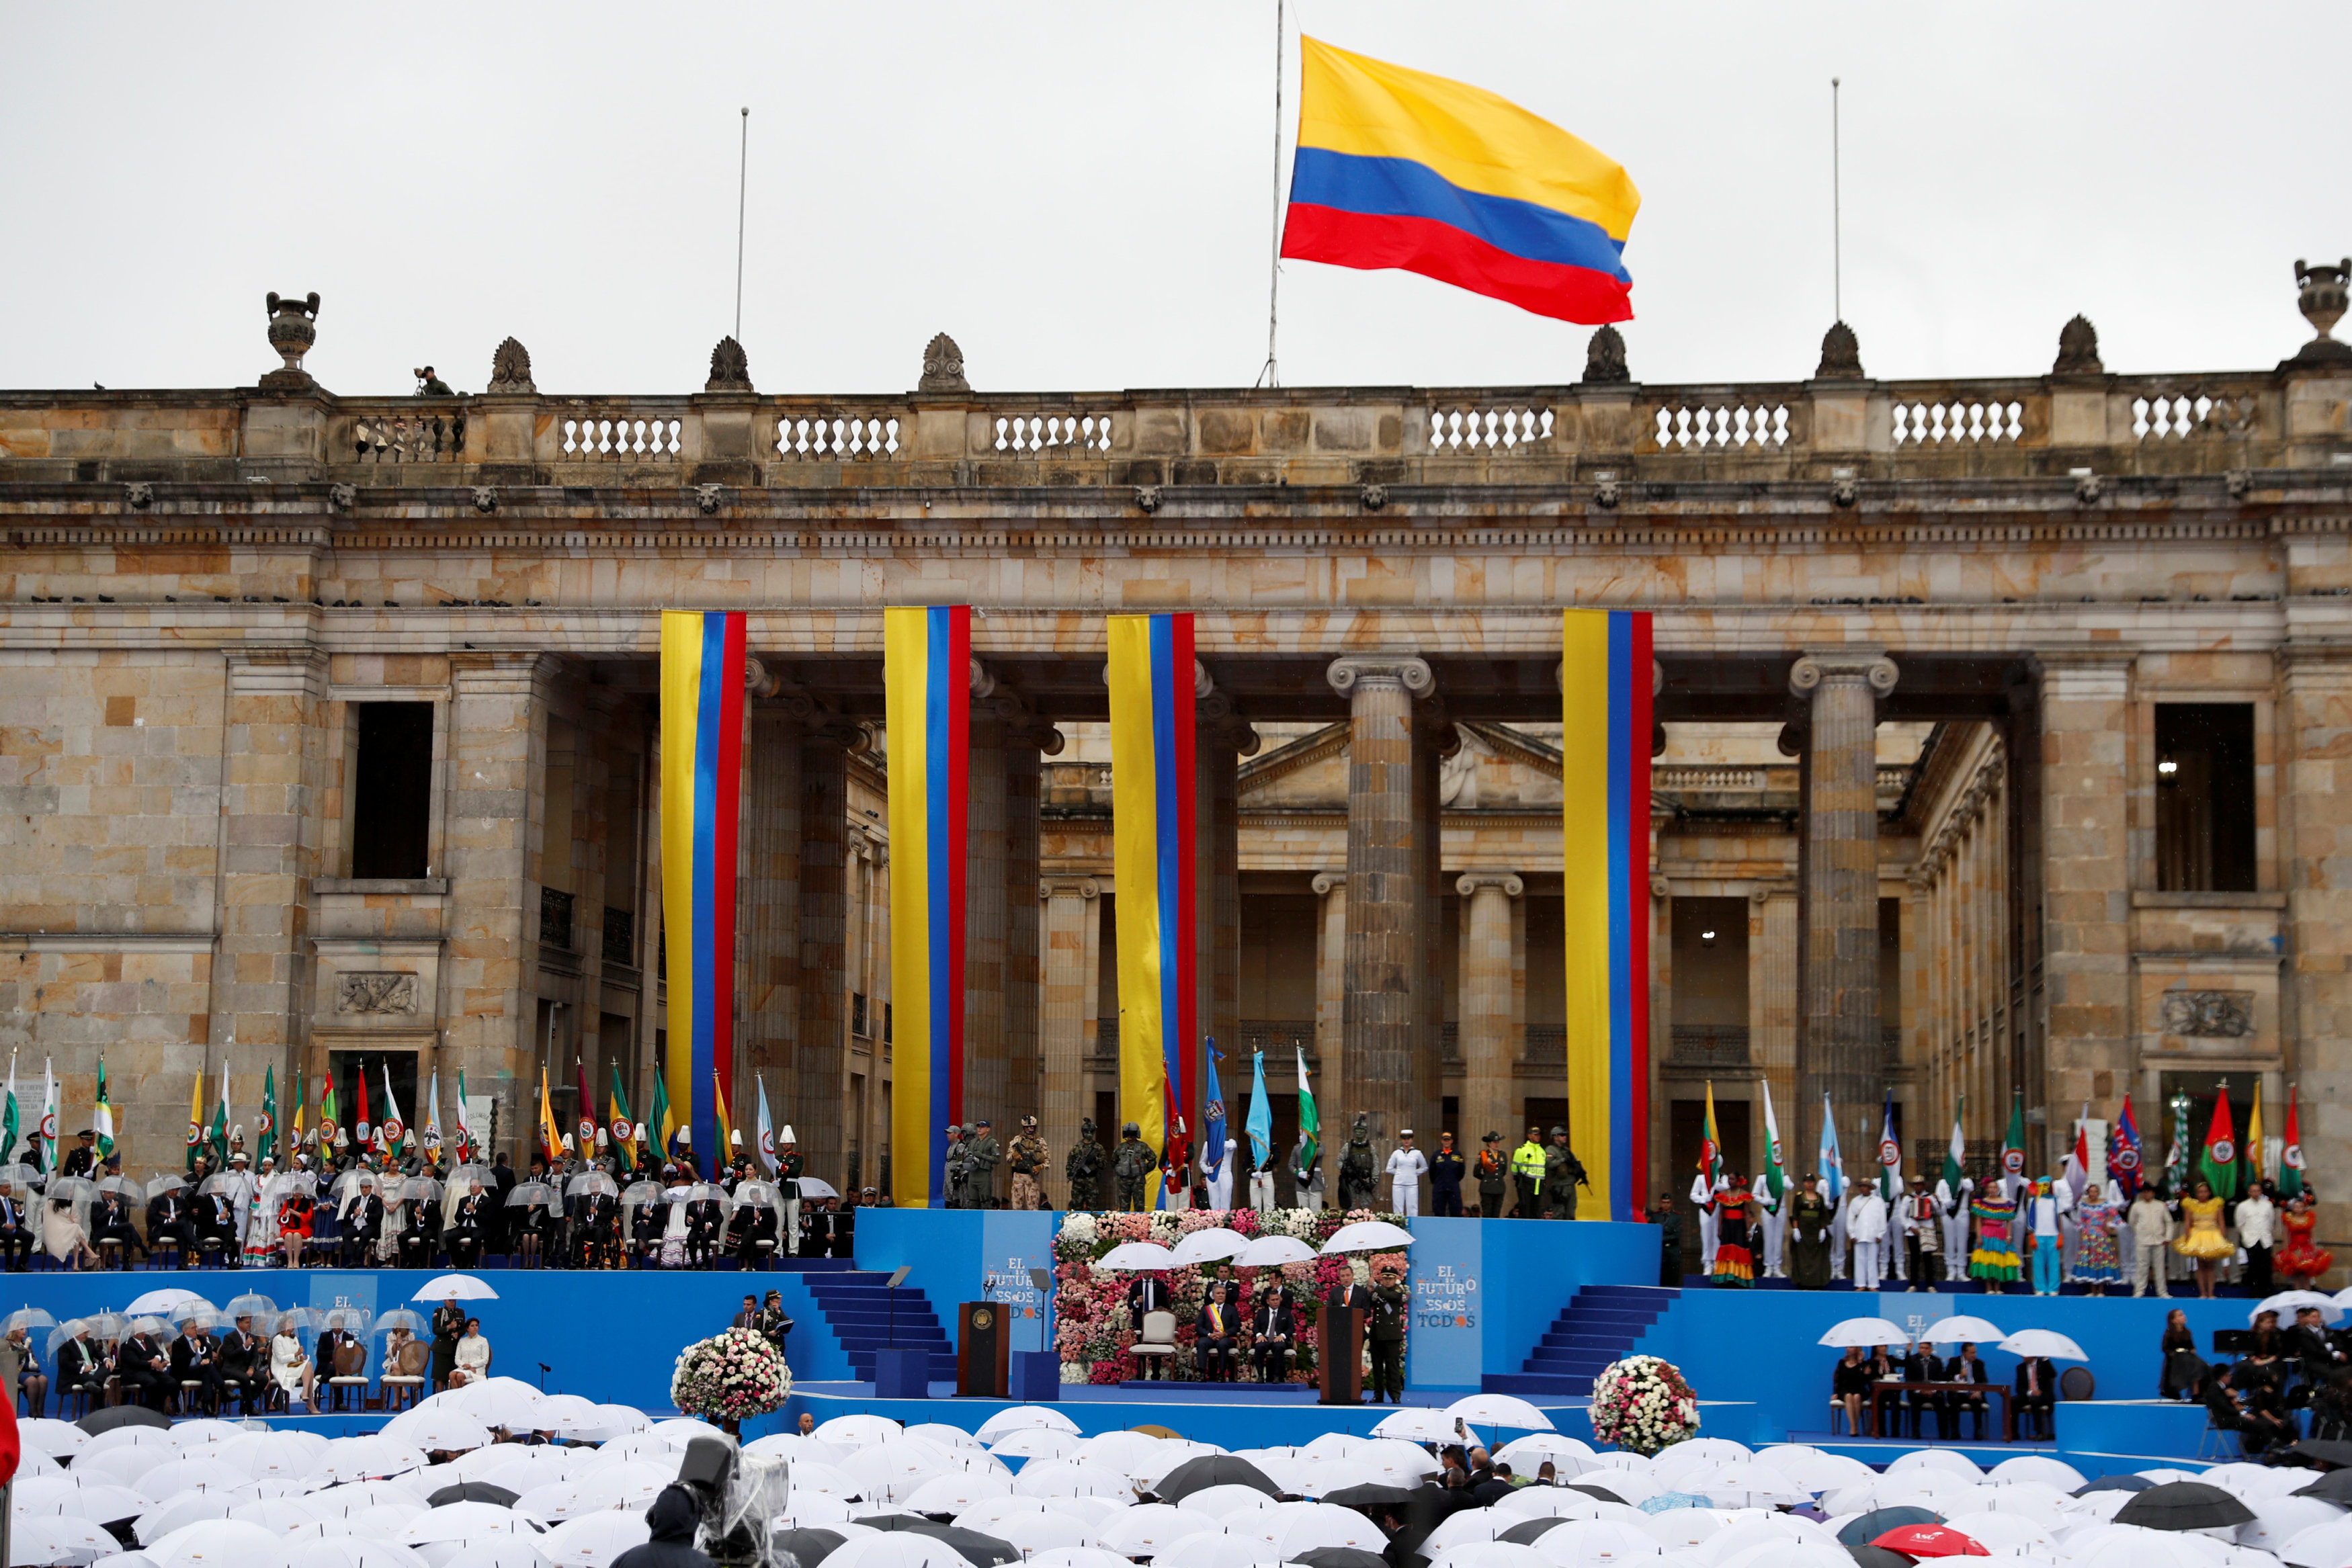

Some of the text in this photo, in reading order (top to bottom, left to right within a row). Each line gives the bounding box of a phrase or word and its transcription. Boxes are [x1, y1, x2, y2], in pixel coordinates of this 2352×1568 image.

[1008, 1258, 1025, 1269] EL
[1437, 1266, 1456, 1277] EL
[988, 1274, 1034, 1287] FUTUR
[1417, 1279, 1476, 1295] FUTURO
[335, 1296, 351, 1308] EL
[996, 1291, 1011, 1302] ES
[1426, 1299, 1443, 1311] ES
[1908, 1315, 1927, 1327] EL
